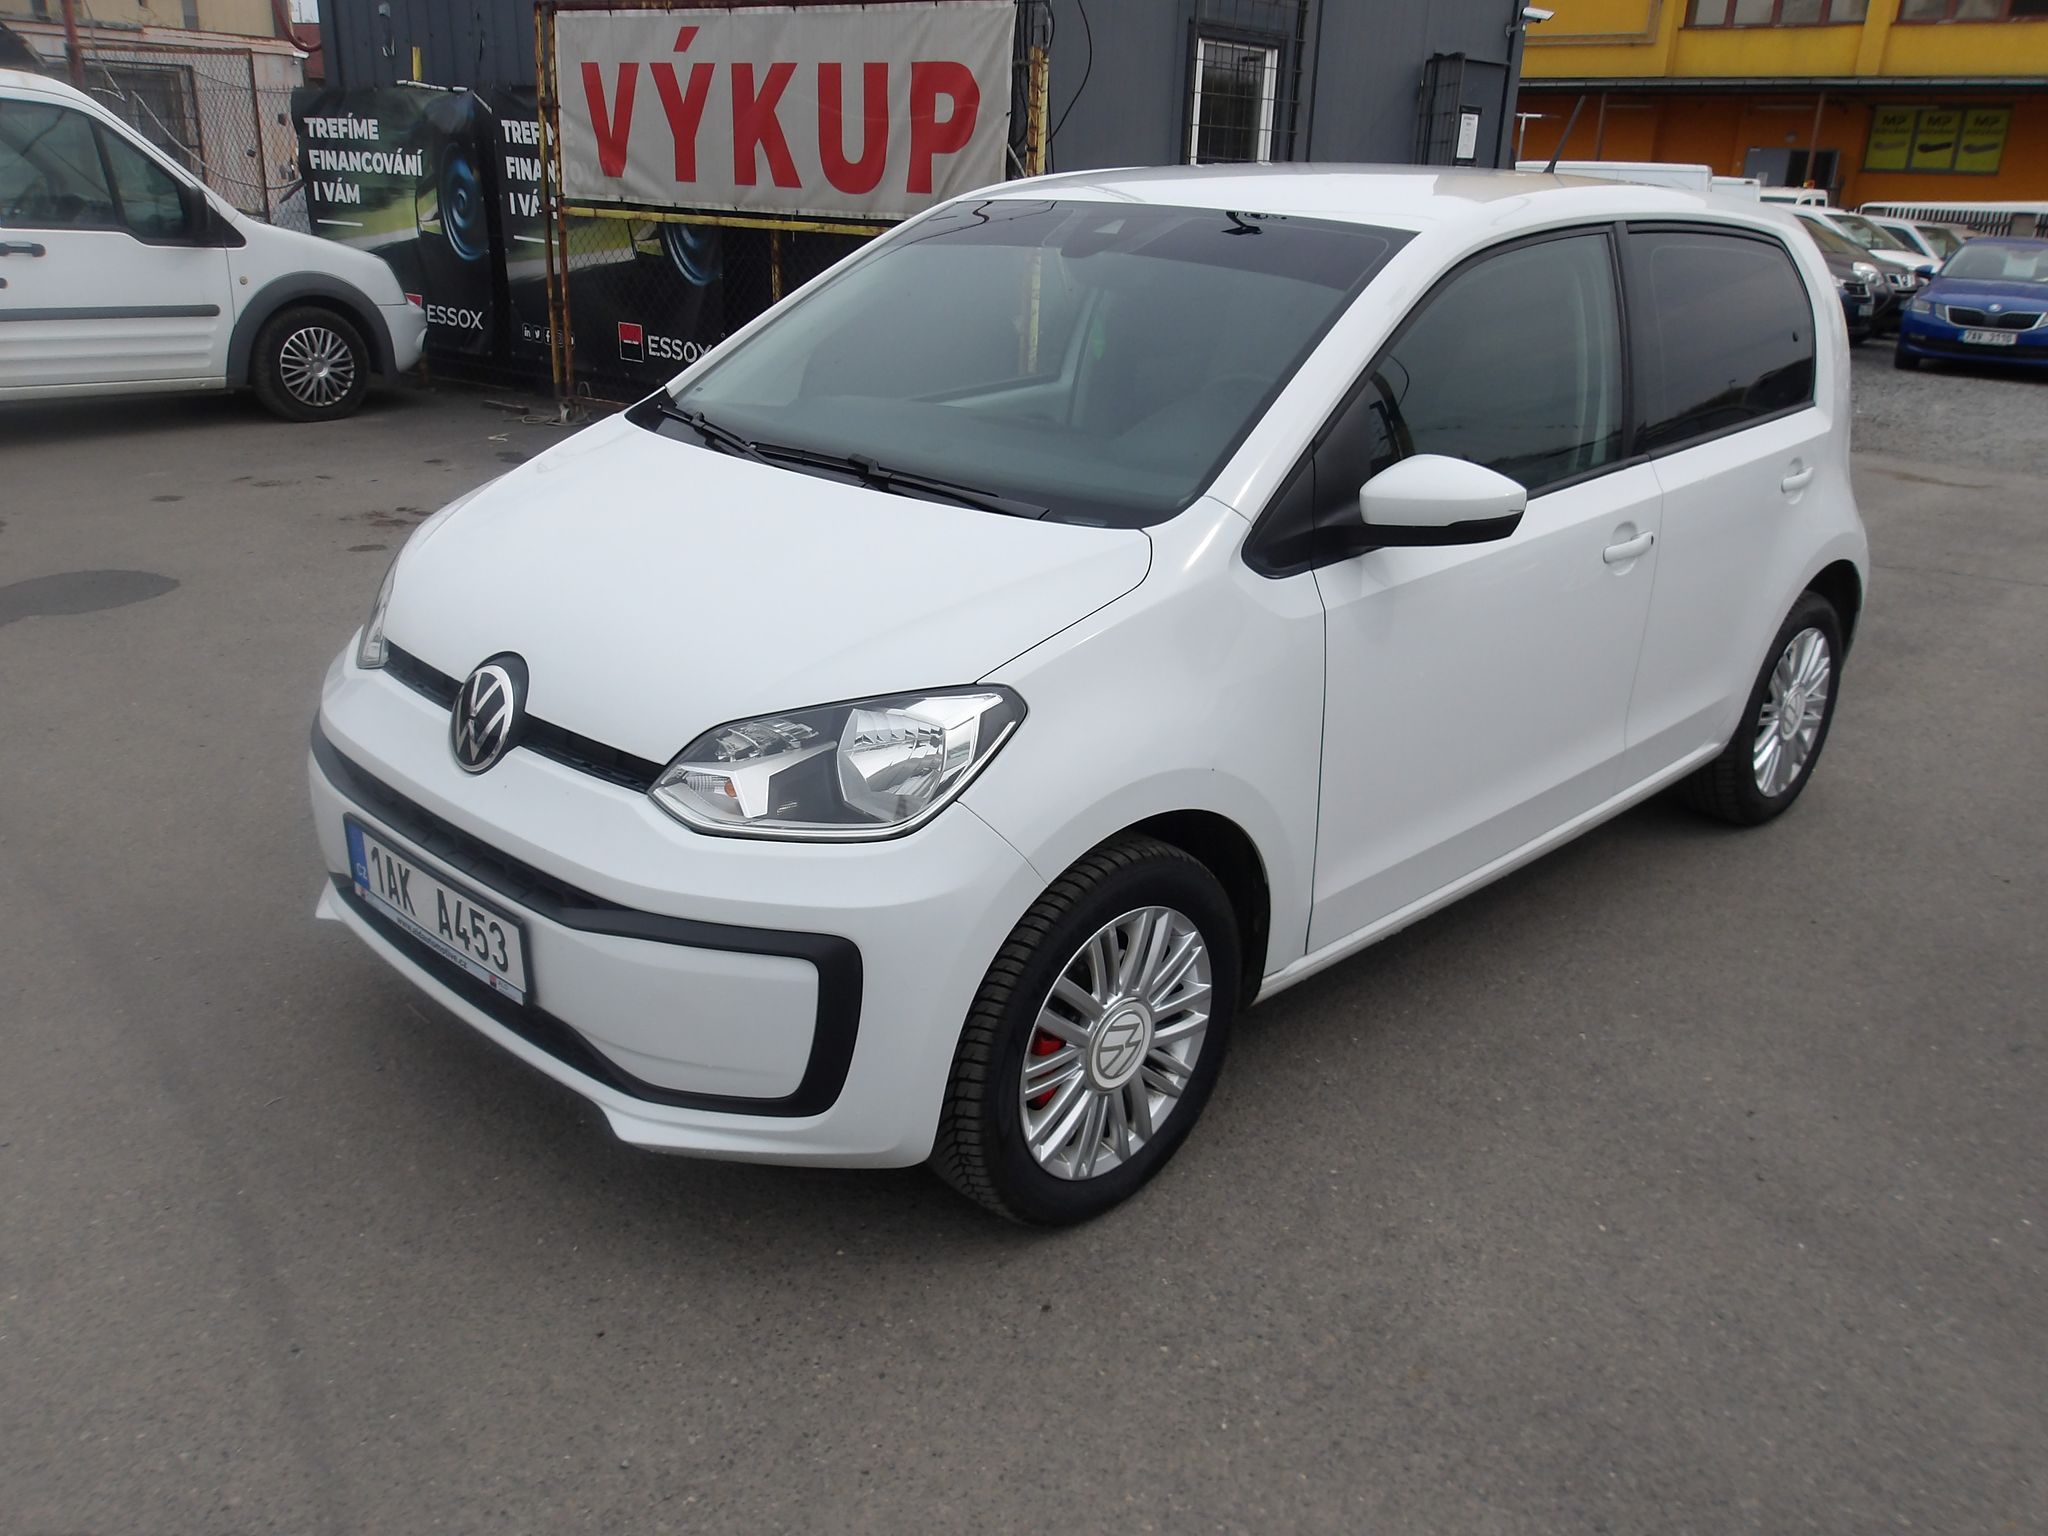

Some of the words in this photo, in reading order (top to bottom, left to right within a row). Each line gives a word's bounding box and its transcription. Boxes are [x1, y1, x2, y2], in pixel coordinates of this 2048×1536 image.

[581, 26, 981, 195] VÝKUP
[303, 112, 380, 140] TREFÍME
[308, 147, 423, 176] FINANCOVÁNÍ
[313, 181, 321, 201] I
[321, 177, 360, 204] VÁM
[509, 192, 516, 215] I
[427, 304, 483, 330] ESSOX
[371, 847, 416, 917] 1AK
[436, 888, 509, 973] A453
